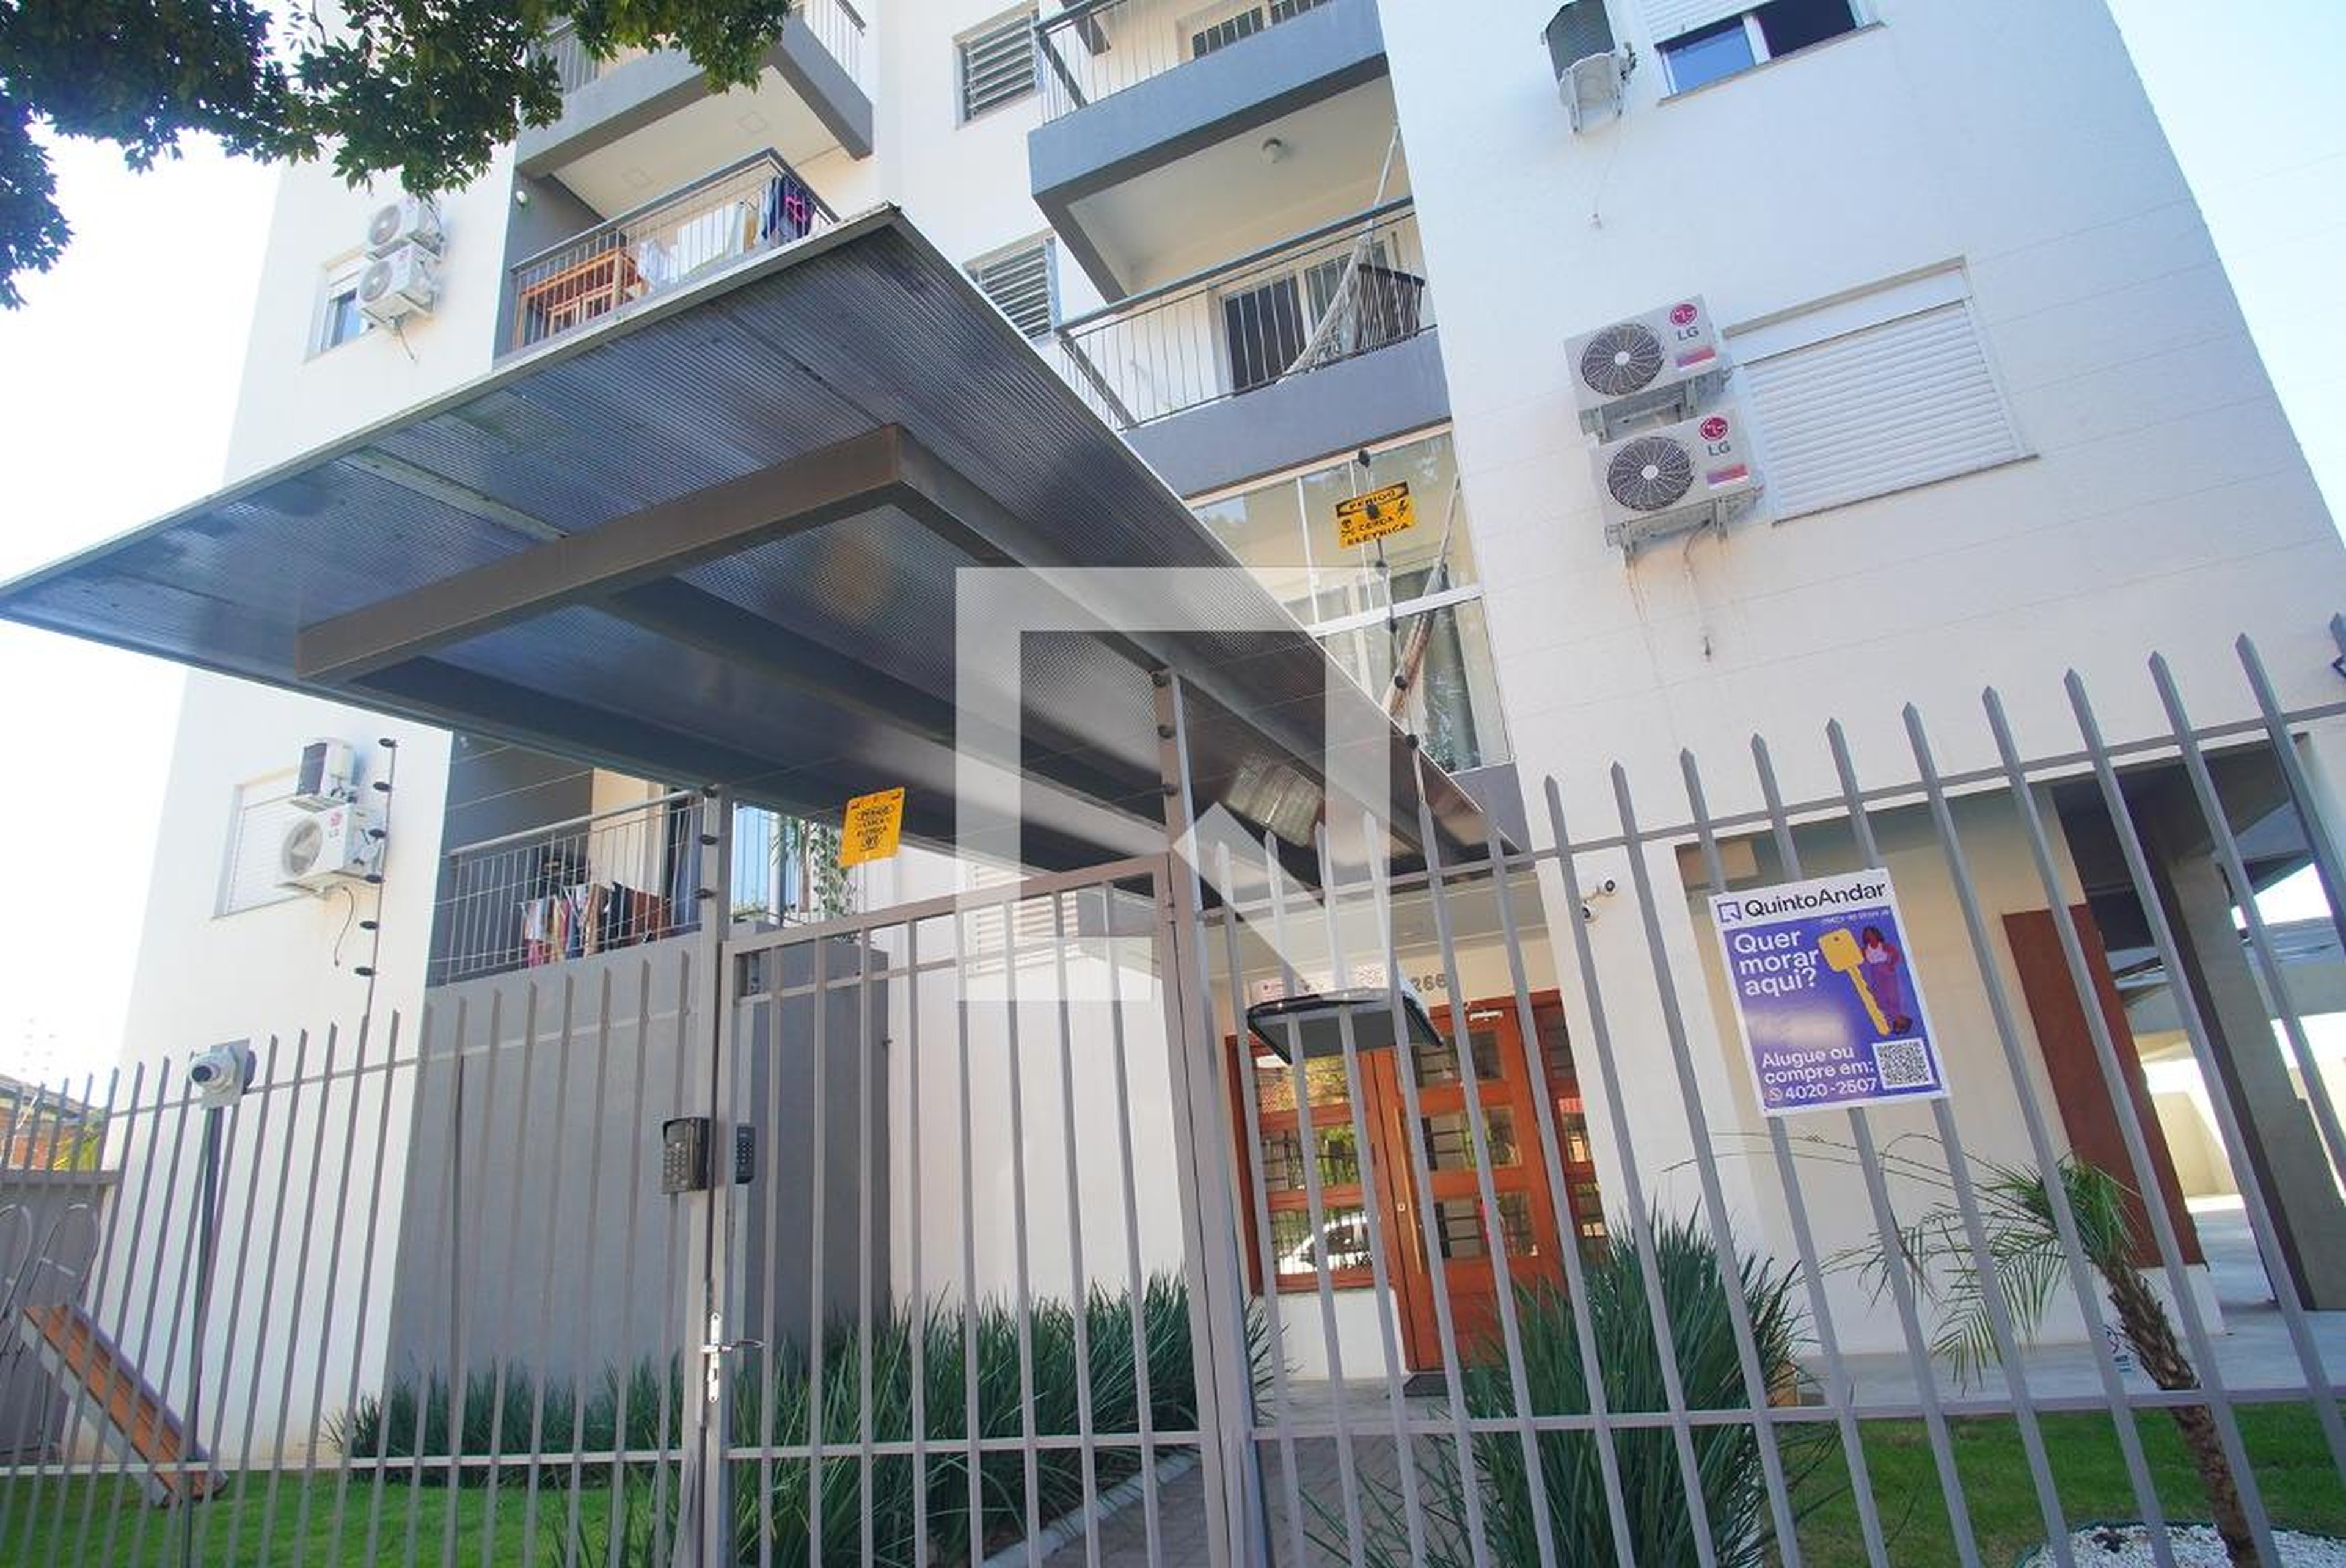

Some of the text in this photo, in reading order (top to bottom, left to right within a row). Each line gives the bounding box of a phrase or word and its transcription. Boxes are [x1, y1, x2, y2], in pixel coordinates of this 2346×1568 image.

[1677, 326, 1699, 341] LG
[1708, 440, 1730, 456] LG
[1745, 883, 1886, 916] QuintoAndar
[1734, 930, 1801, 954] Quer
[1739, 949, 1819, 975] morar
[1744, 966, 1816, 997] aqui?
[1762, 1047, 1855, 1068] Alugue ou
[1764, 1061, 1874, 1084] compre em:
